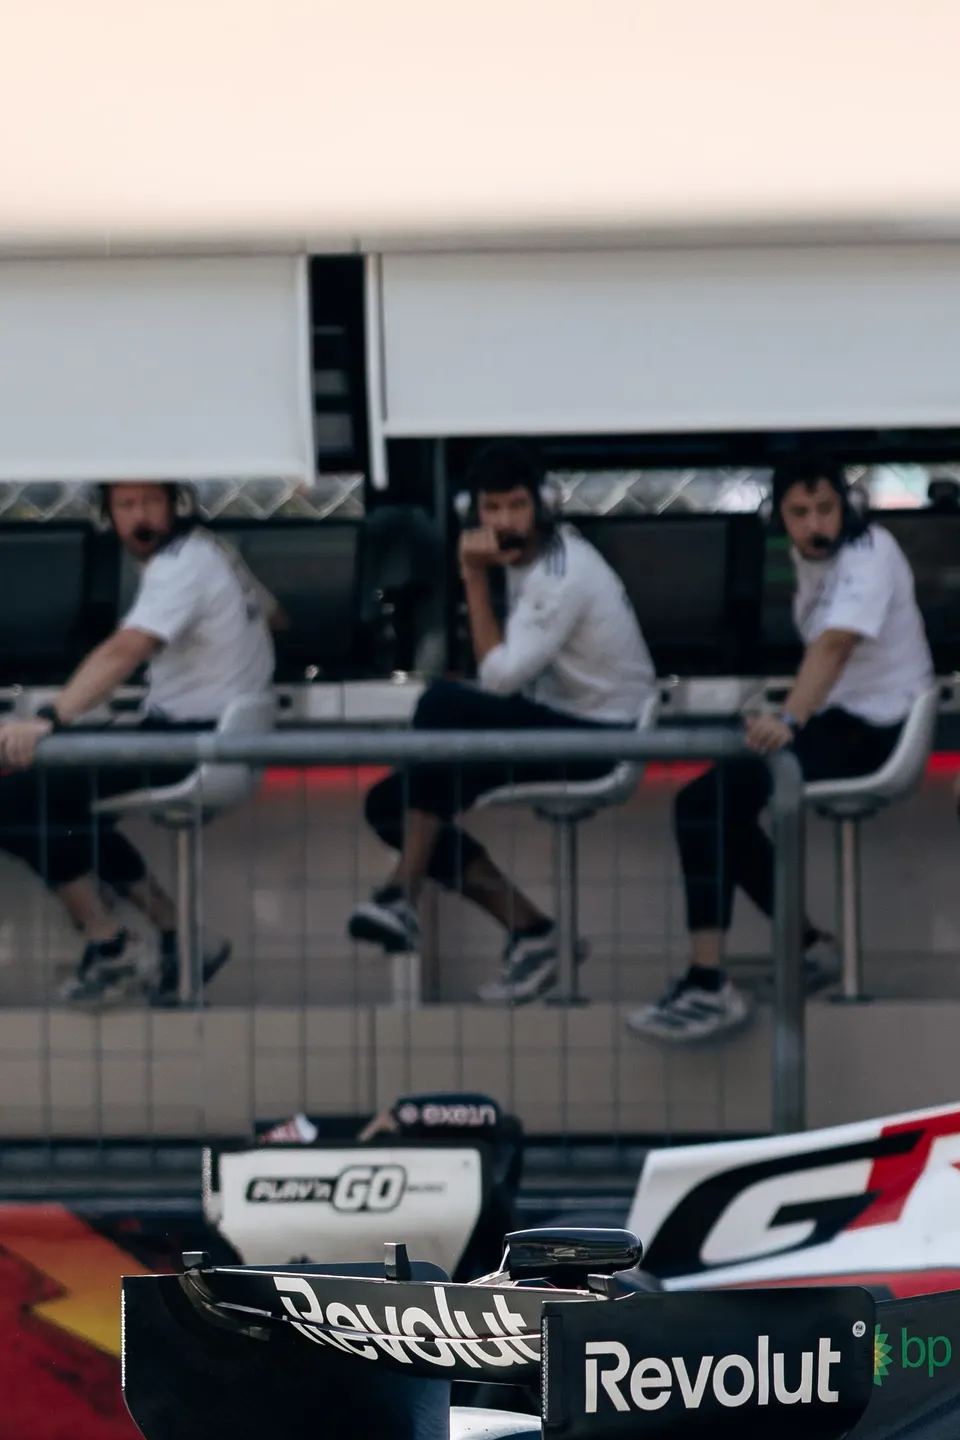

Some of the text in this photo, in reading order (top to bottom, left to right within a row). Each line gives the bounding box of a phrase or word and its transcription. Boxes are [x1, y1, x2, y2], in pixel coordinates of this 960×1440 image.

[334, 1168, 403, 1211] GO
[274, 1277, 541, 1368] Revolut
[901, 1327, 951, 1377] bp
[585, 1335, 841, 1413] Revolut
